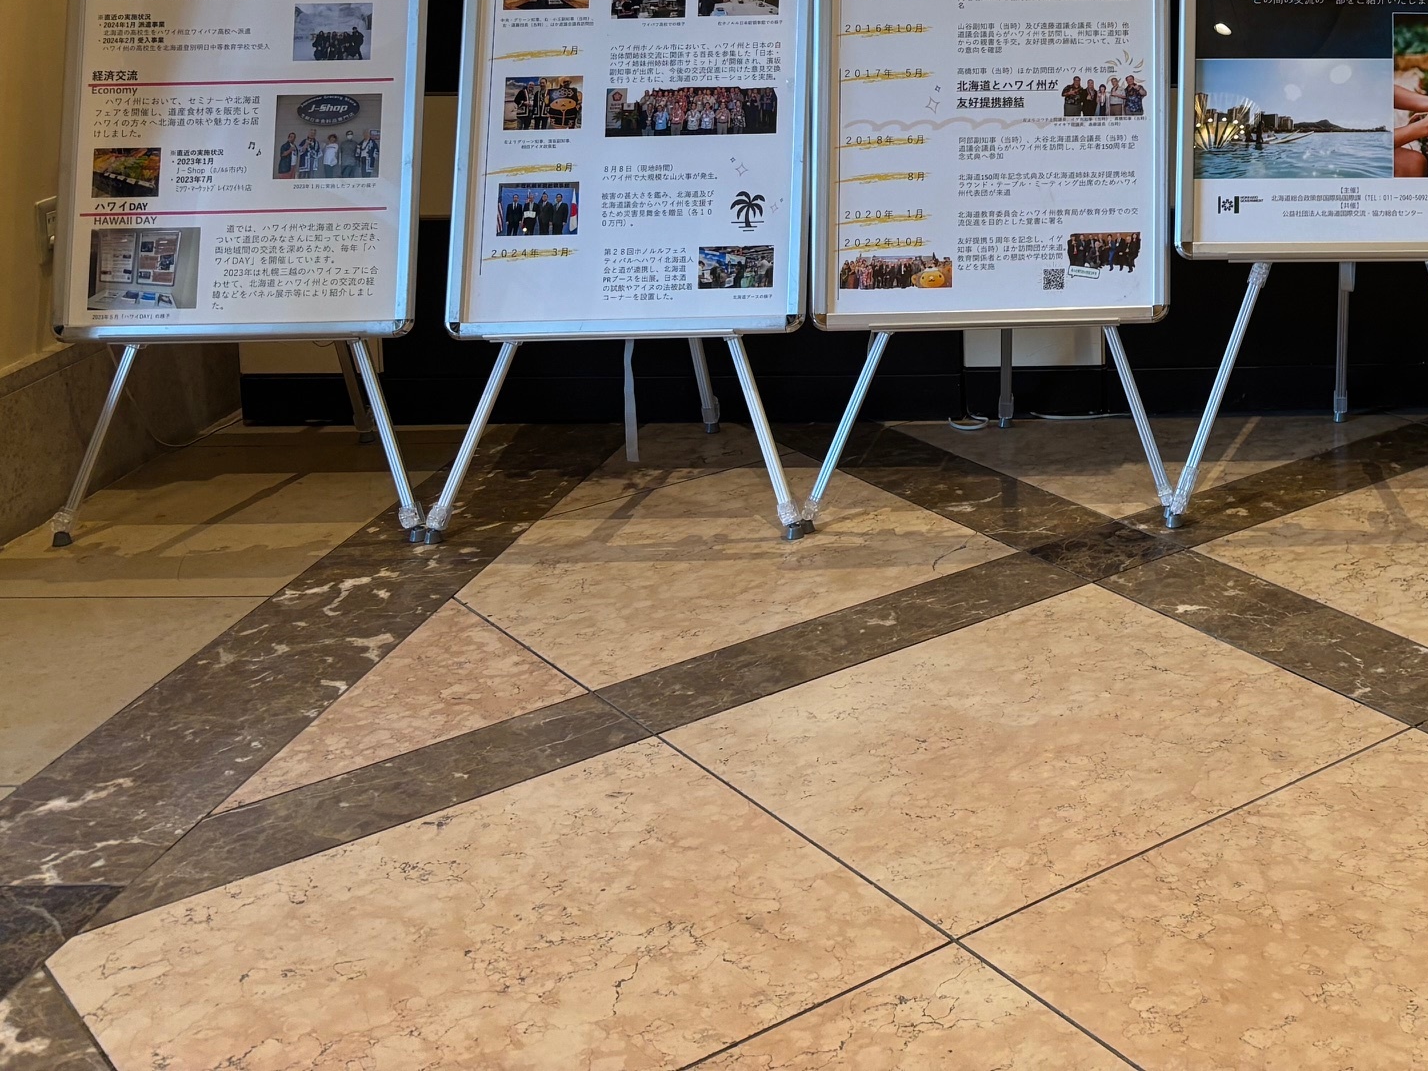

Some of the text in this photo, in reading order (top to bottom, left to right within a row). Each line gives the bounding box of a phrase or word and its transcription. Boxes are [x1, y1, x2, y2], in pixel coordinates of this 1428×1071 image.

[844, 23, 924, 34] 2016年10月
[562, 45, 580, 56] 7月
[91, 70, 139, 82] 経済交流
[844, 68, 923, 79] 2017年 5月
[91, 85, 138, 96] Economy
[957, 79, 1059, 91] 北海道とハワイ州が
[956, 97, 1025, 108] 友好提携締結
[308, 104, 349, 113] J-Shop
[845, 134, 925, 146] 2018年 6月
[555, 162, 574, 173] 8月
[907, 171, 925, 182] 8月
[94, 201, 149, 212] ハワイDAY
[844, 208, 895, 220] 2020年
[93, 216, 157, 226] HAWAII DAY
[844, 236, 923, 248] 2022年10月
[490, 247, 570, 259] 2024年 3月
